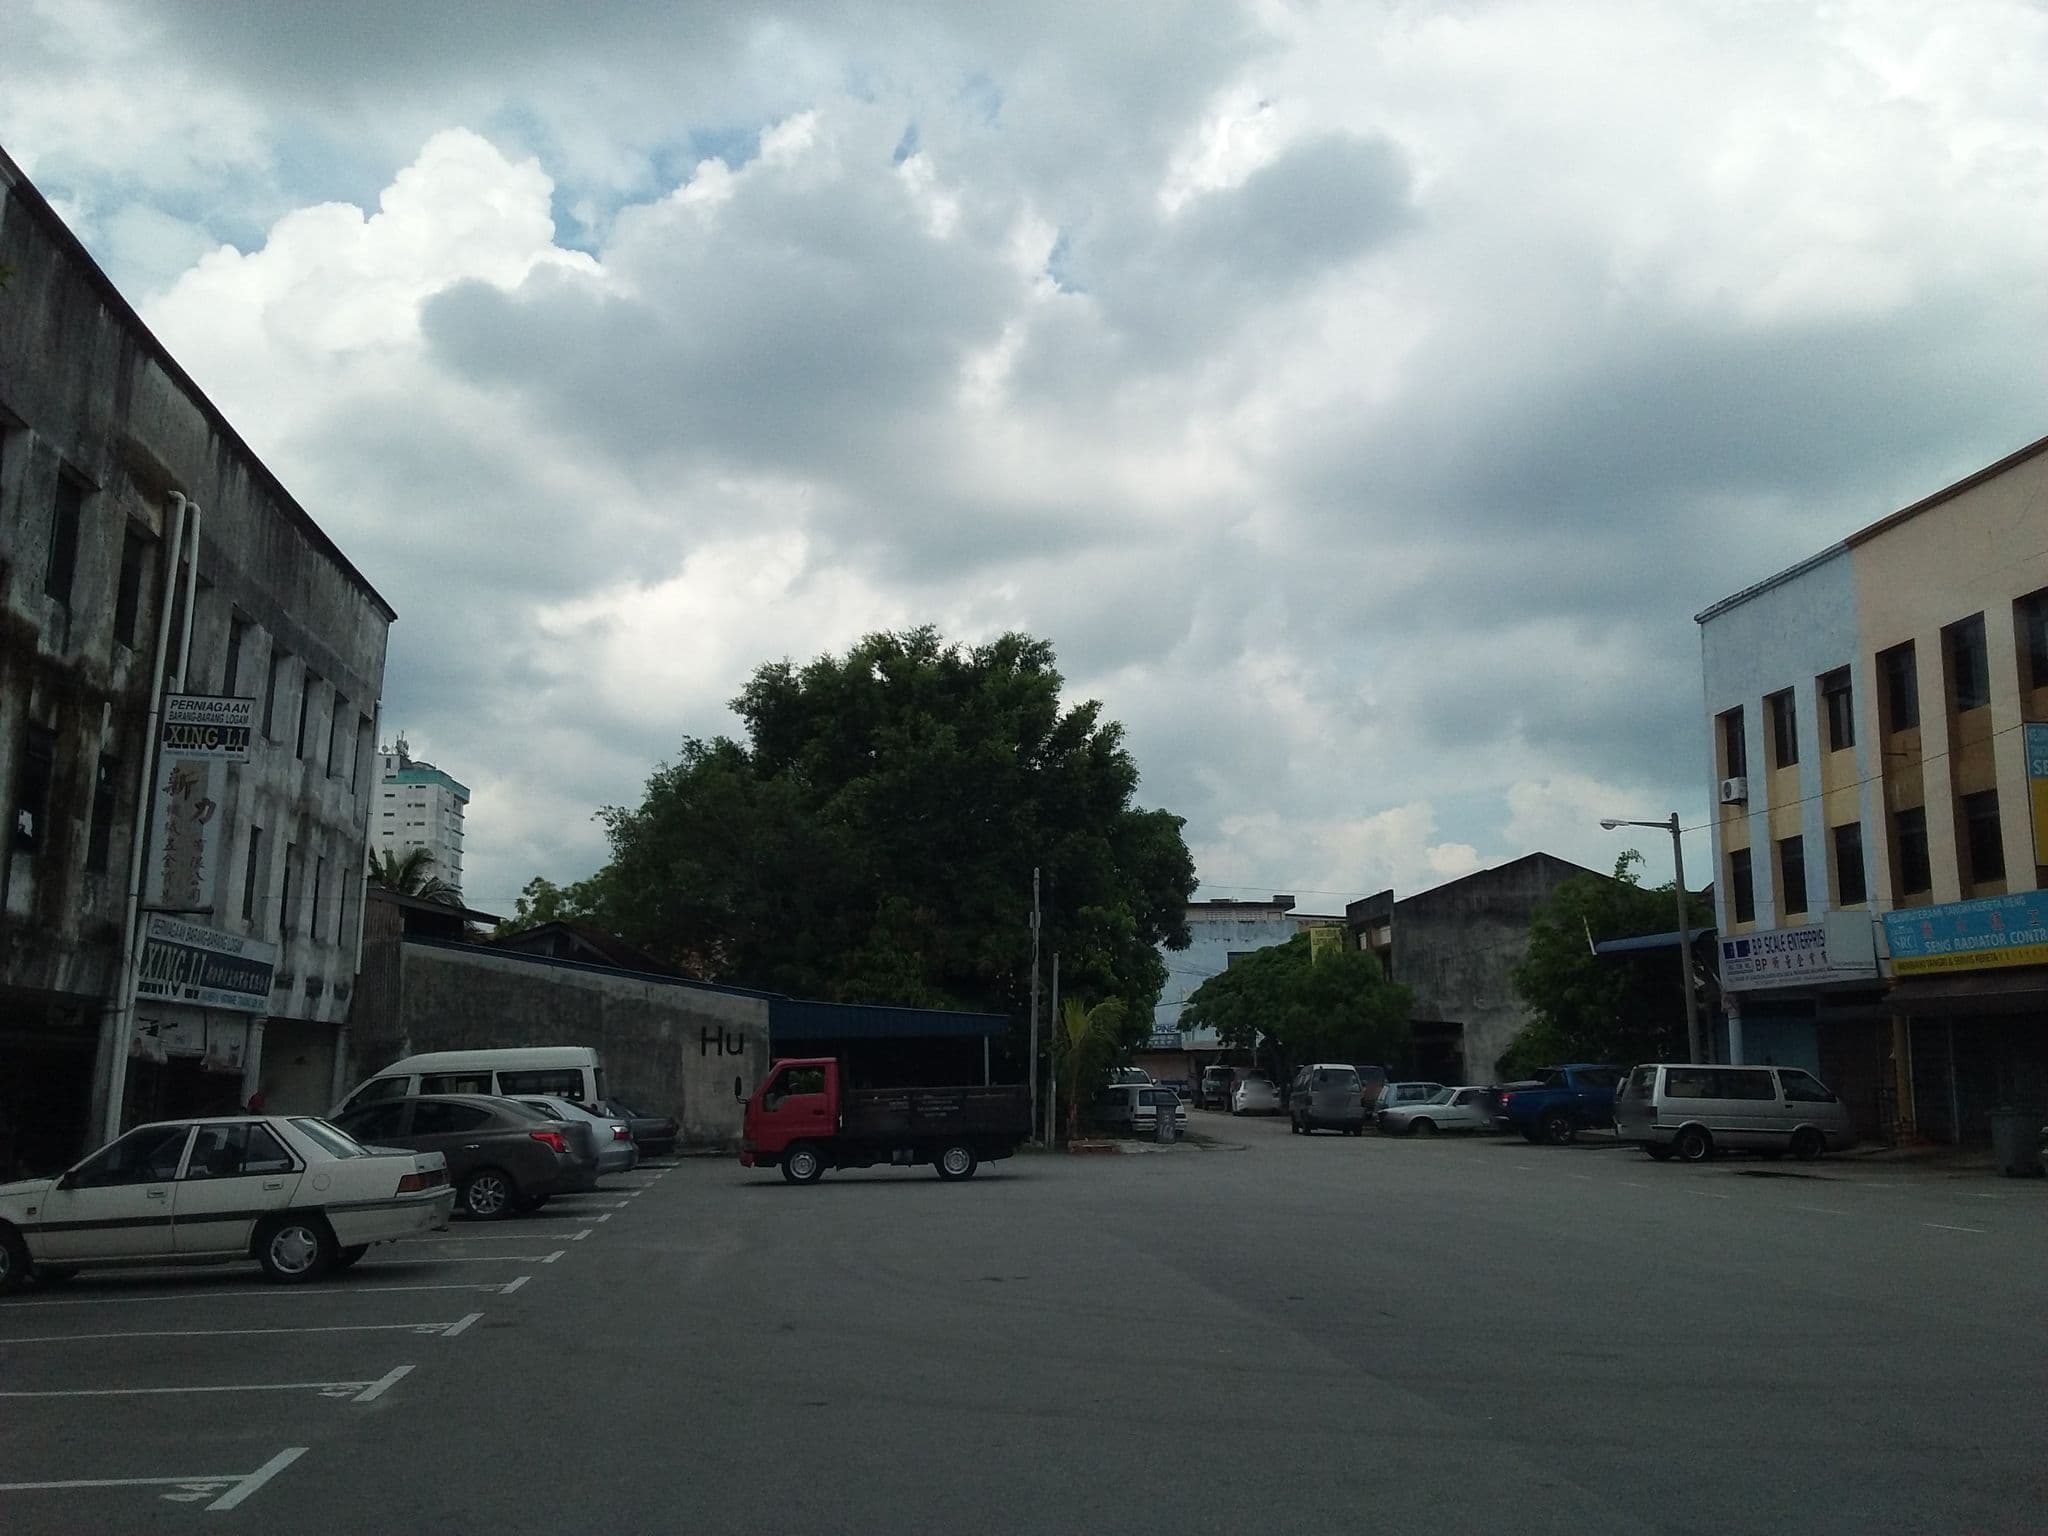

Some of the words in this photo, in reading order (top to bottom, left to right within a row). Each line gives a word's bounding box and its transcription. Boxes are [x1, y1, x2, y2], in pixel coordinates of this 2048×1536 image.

[170, 699, 250, 713] PERNIAGAAN
[168, 726, 219, 746] XING
[226, 728, 246, 748] LI
[1764, 933, 1787, 955] SCALE
[1787, 928, 1826, 951] ENTERPRIS
[1954, 933, 2006, 950] RADIATOR
[1755, 957, 1768, 972] BP
[701, 1024, 744, 1056] Hu
